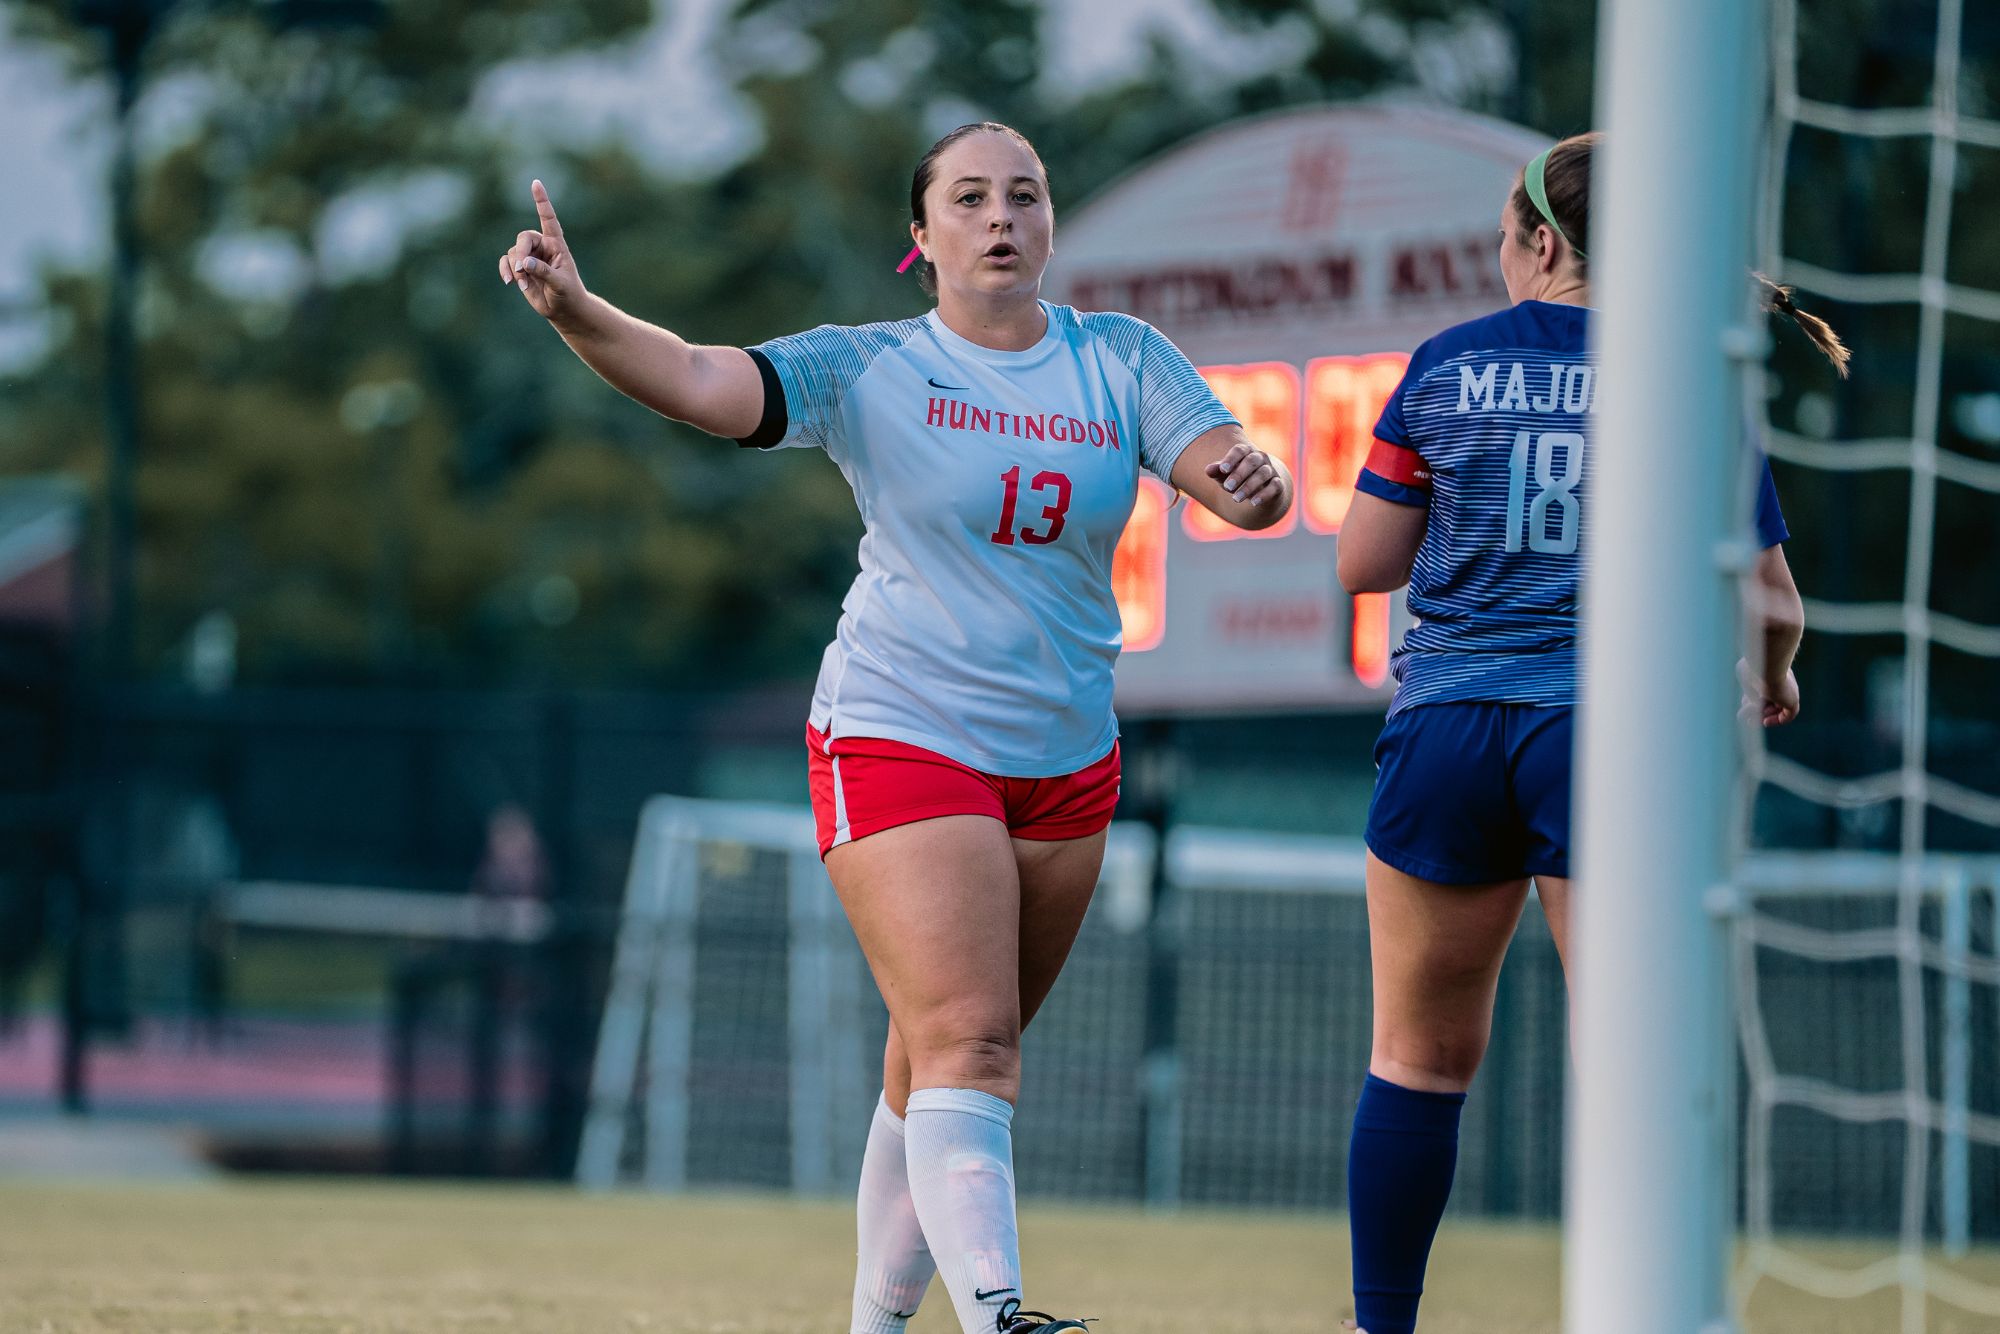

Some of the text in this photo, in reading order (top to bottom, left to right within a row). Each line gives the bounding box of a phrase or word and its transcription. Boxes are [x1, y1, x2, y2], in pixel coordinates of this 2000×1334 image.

[926, 397, 1121, 450] HUNTINGDON
[990, 465, 1072, 546] 13
[1505, 430, 1584, 555] 18
